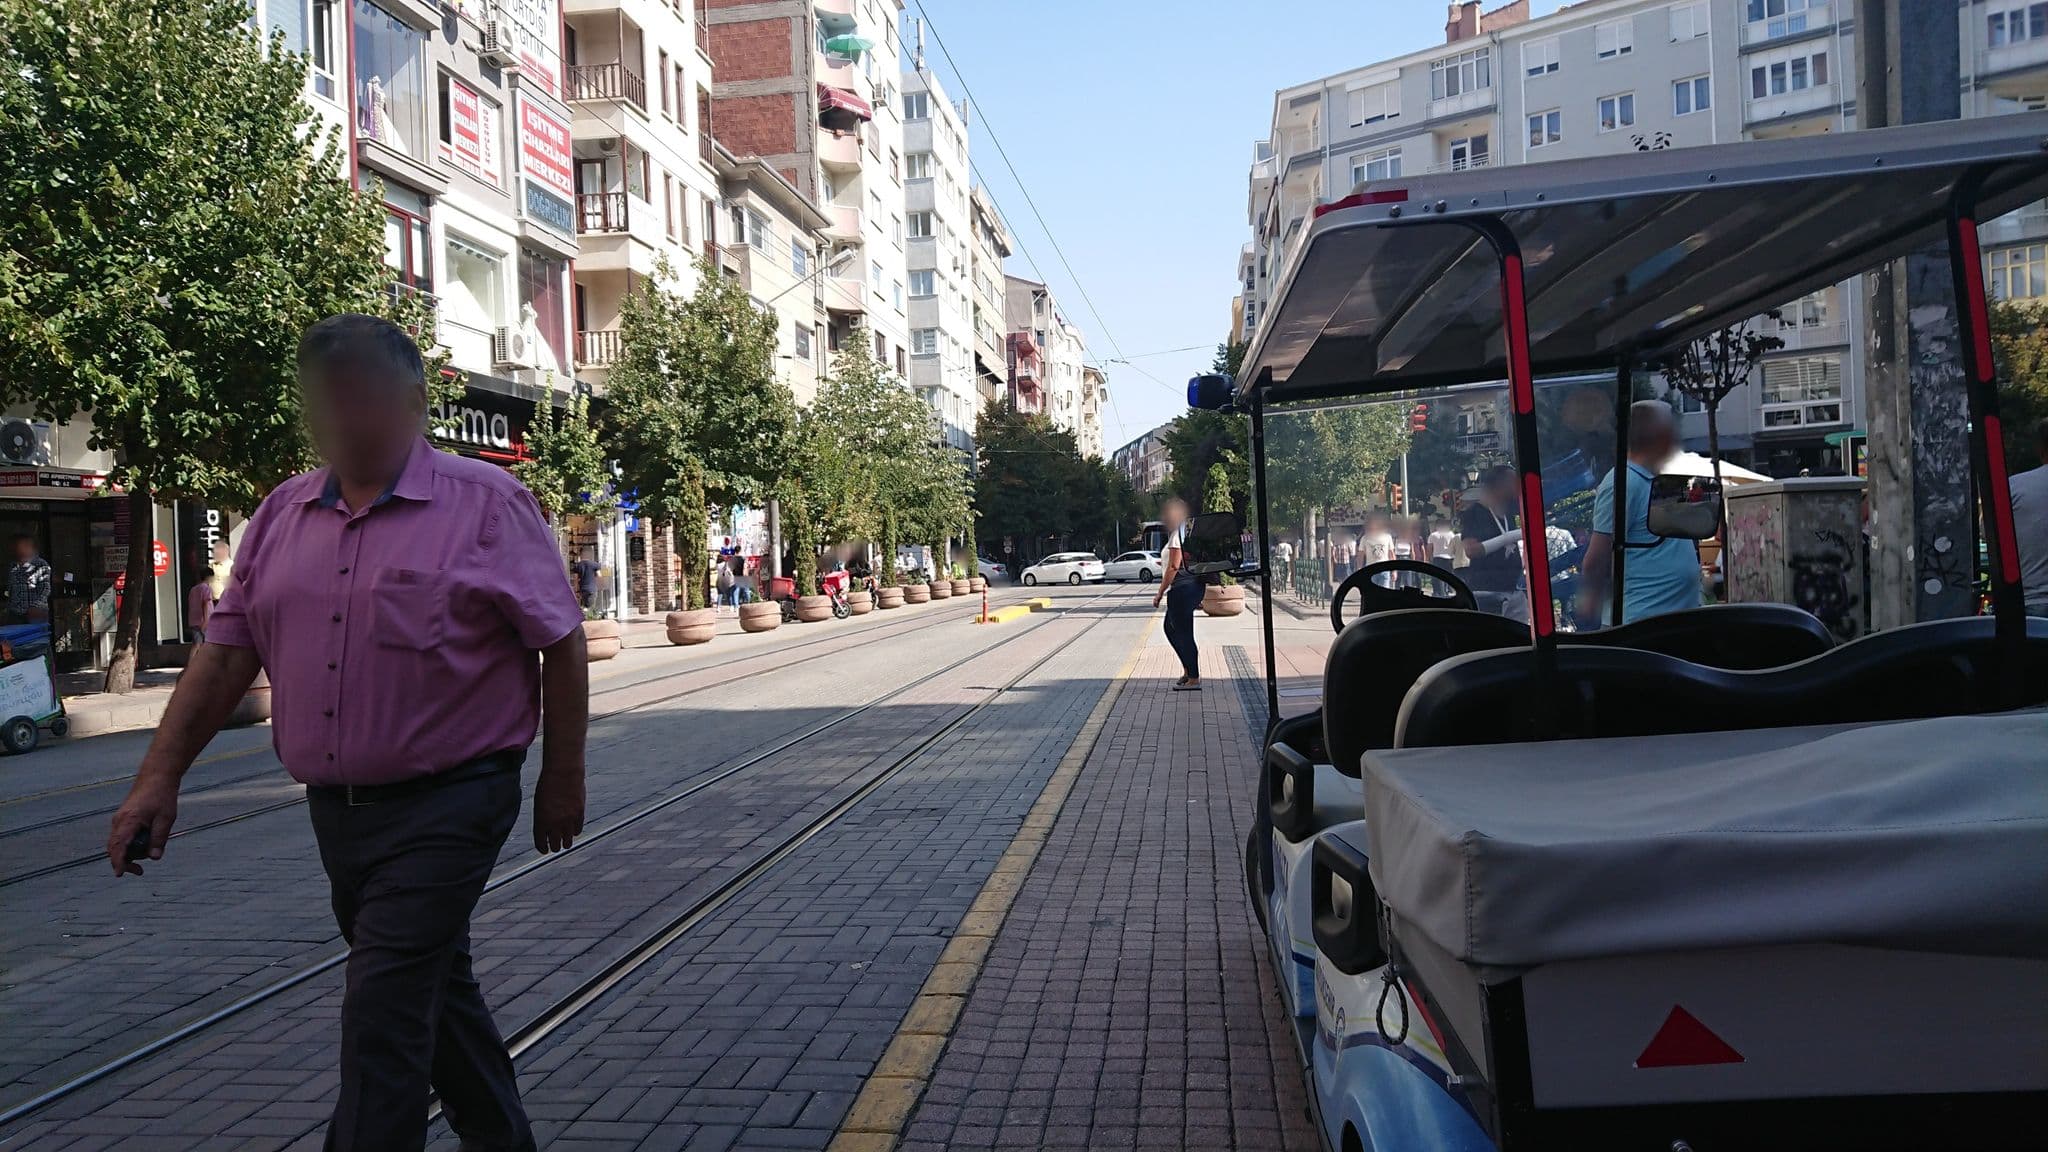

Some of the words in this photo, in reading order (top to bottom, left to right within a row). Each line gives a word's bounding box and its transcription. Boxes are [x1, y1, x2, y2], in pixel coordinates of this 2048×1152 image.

[527, 107, 564, 145] İŞİTME
[523, 129, 570, 168] CİHAZLARI
[523, 153, 570, 189] MERKEZİ
